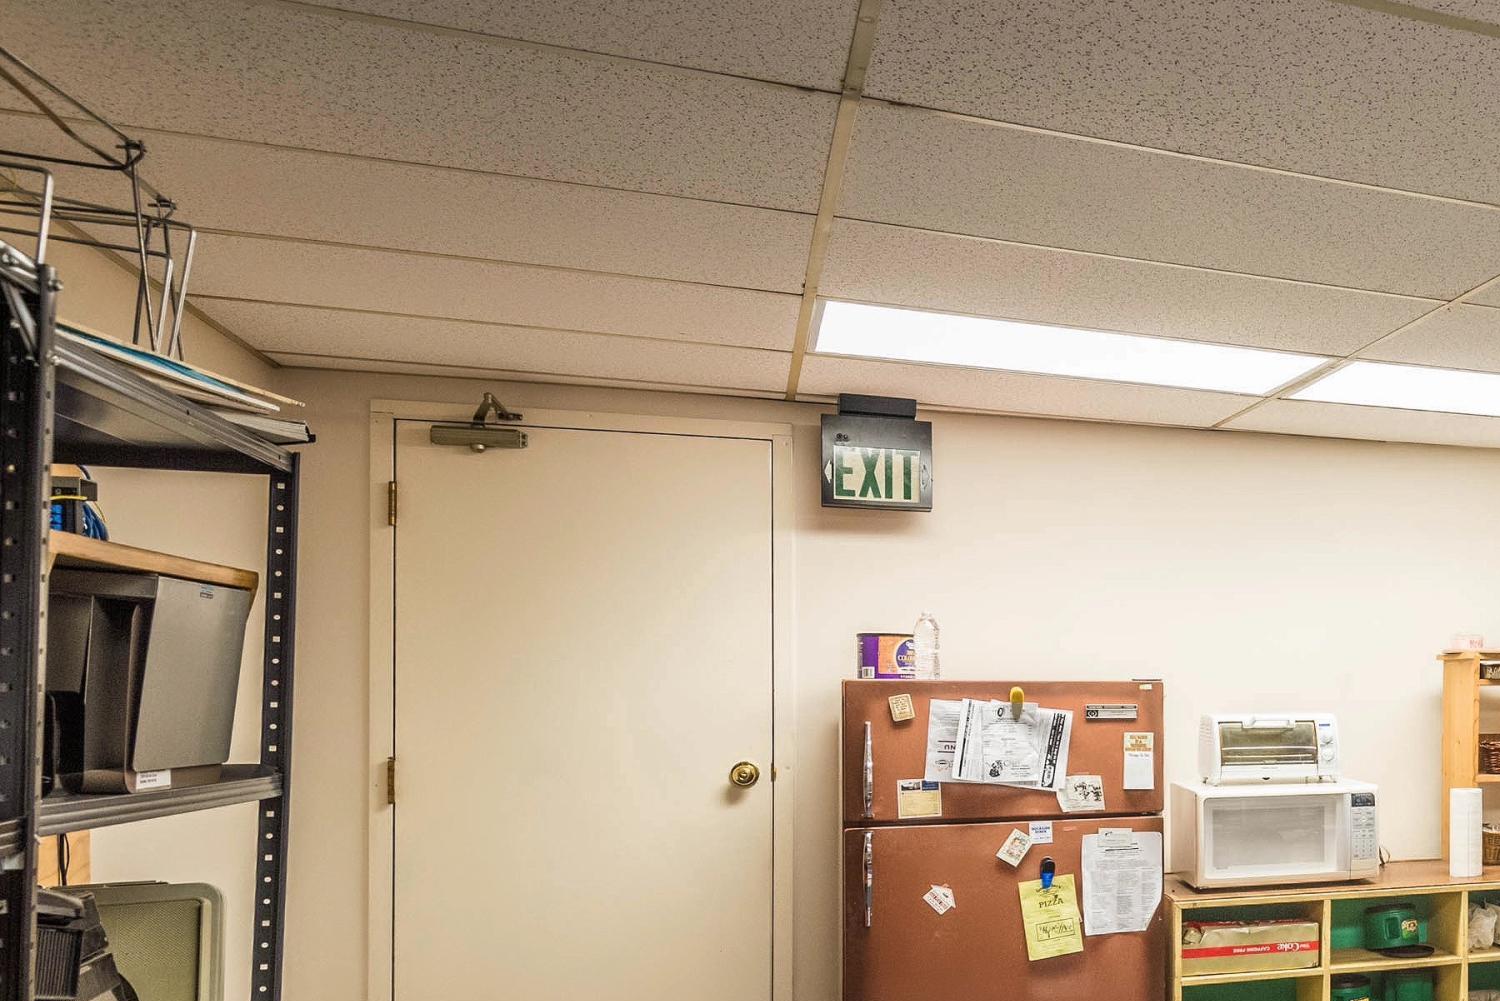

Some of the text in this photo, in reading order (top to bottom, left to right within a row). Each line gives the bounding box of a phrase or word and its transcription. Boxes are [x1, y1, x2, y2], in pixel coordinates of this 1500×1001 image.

[835, 448, 915, 500] EXIT
[1039, 895, 1064, 908] PIZZA
[1277, 943, 1299, 951] Coke
